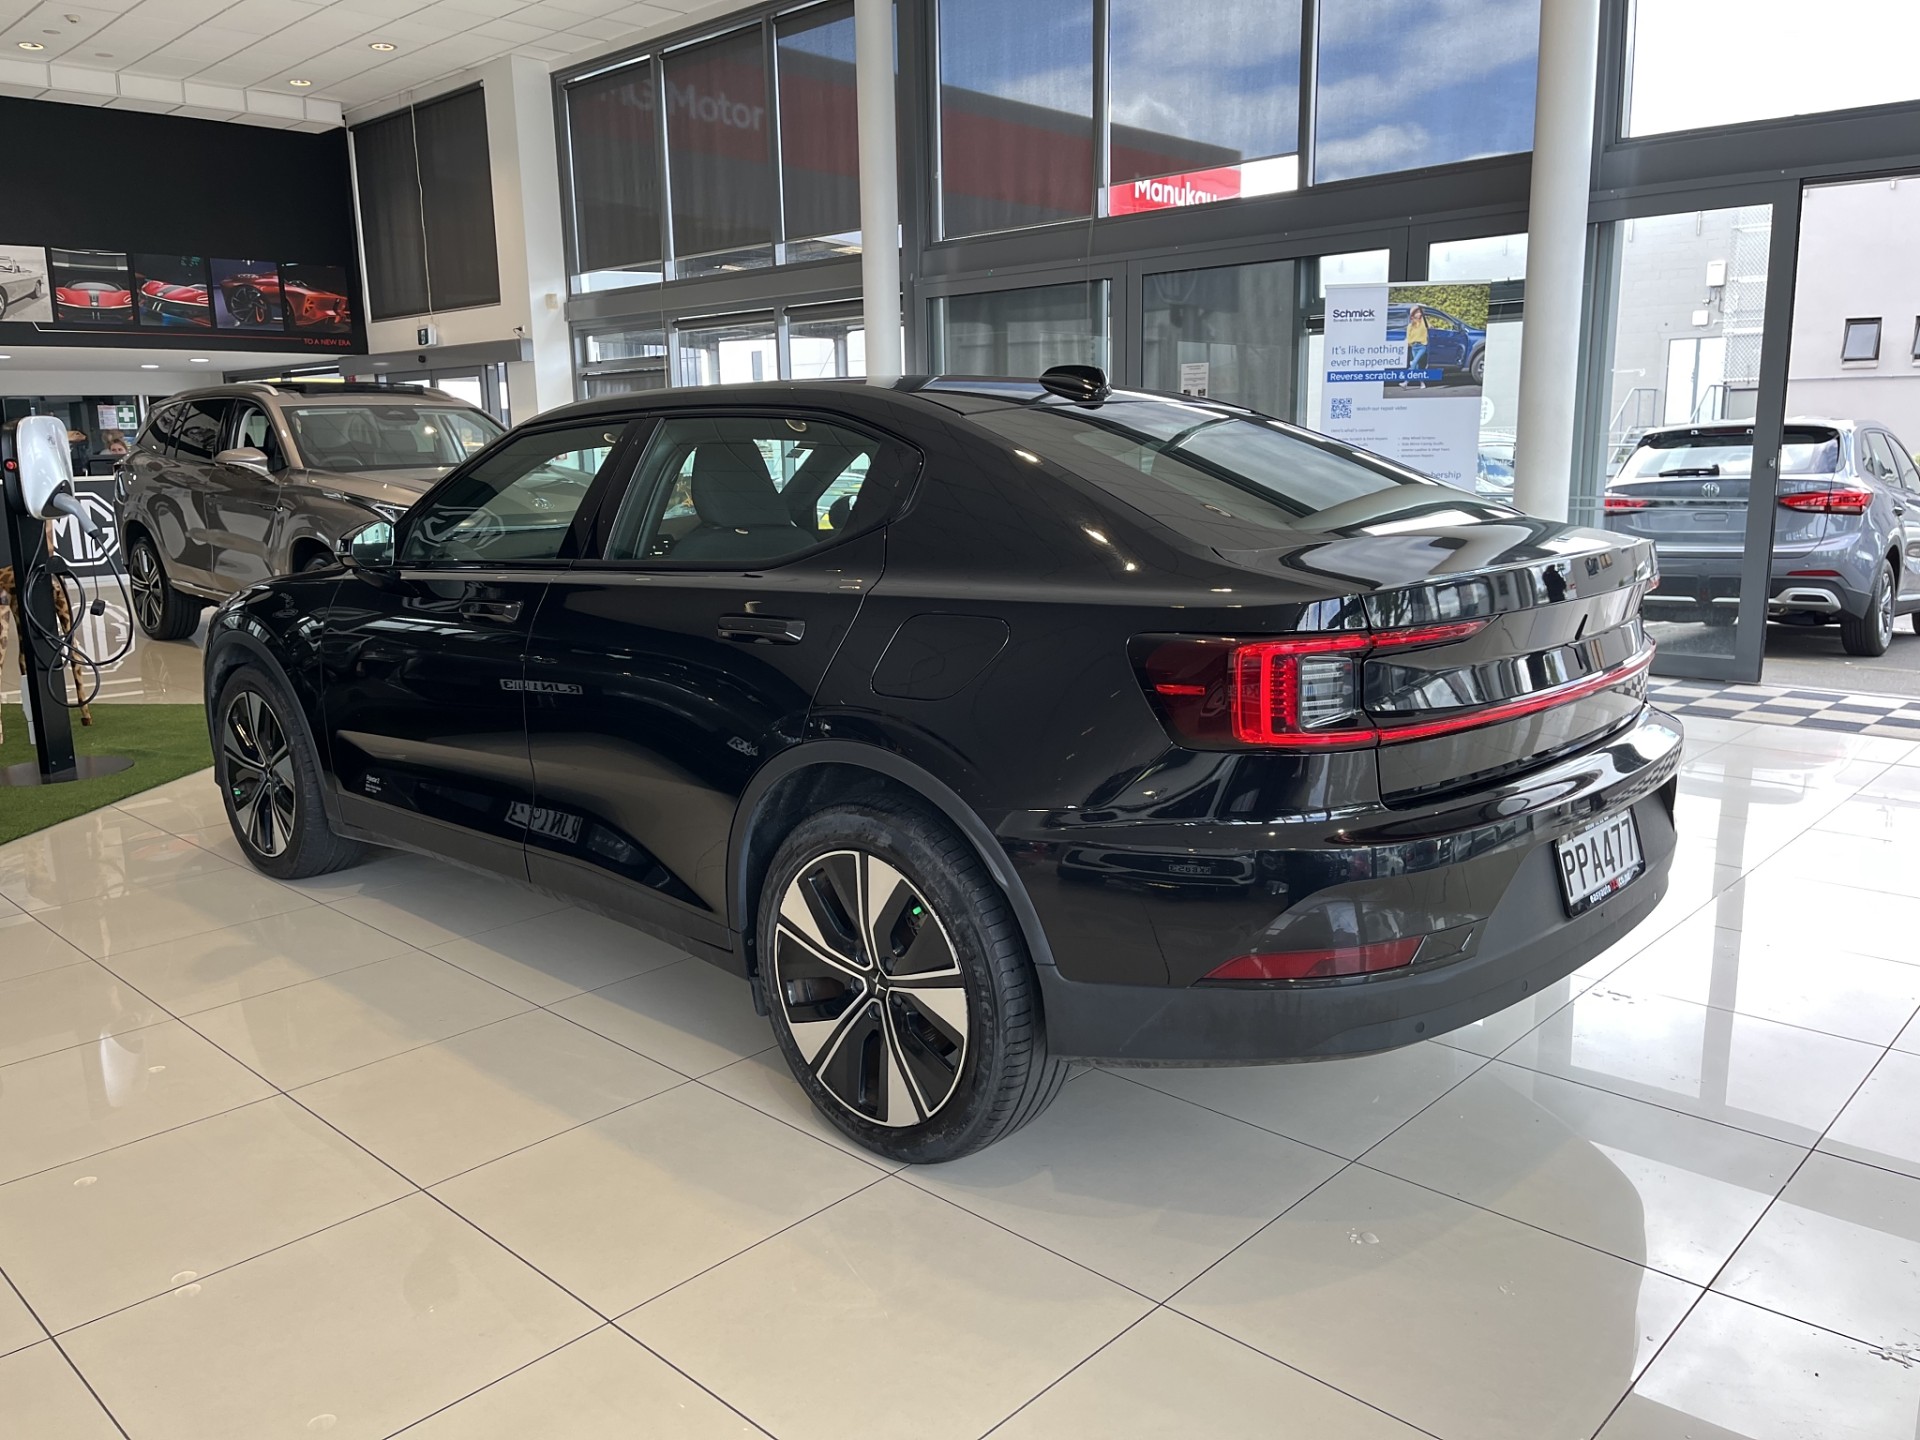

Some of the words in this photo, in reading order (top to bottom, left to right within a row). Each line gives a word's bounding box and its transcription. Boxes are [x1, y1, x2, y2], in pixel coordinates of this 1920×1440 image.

[667, 80, 764, 131] Motor
[1332, 309, 1375, 318] Schmick
[338, 339, 352, 347] ERA
[1332, 346, 1346, 355] It's
[1348, 345, 1365, 355] like
[1367, 344, 1404, 356] nothing
[1330, 359, 1351, 367] ever
[1353, 356, 1404, 368] happened.
[1330, 372, 1363, 381] Reverse
[1365, 371, 1397, 380] scratch
[1399, 371, 1405, 379] &
[1407, 370, 1429, 379] dent.
[52, 499, 115, 560] MG
[1561, 816, 1635, 898] PPA477
